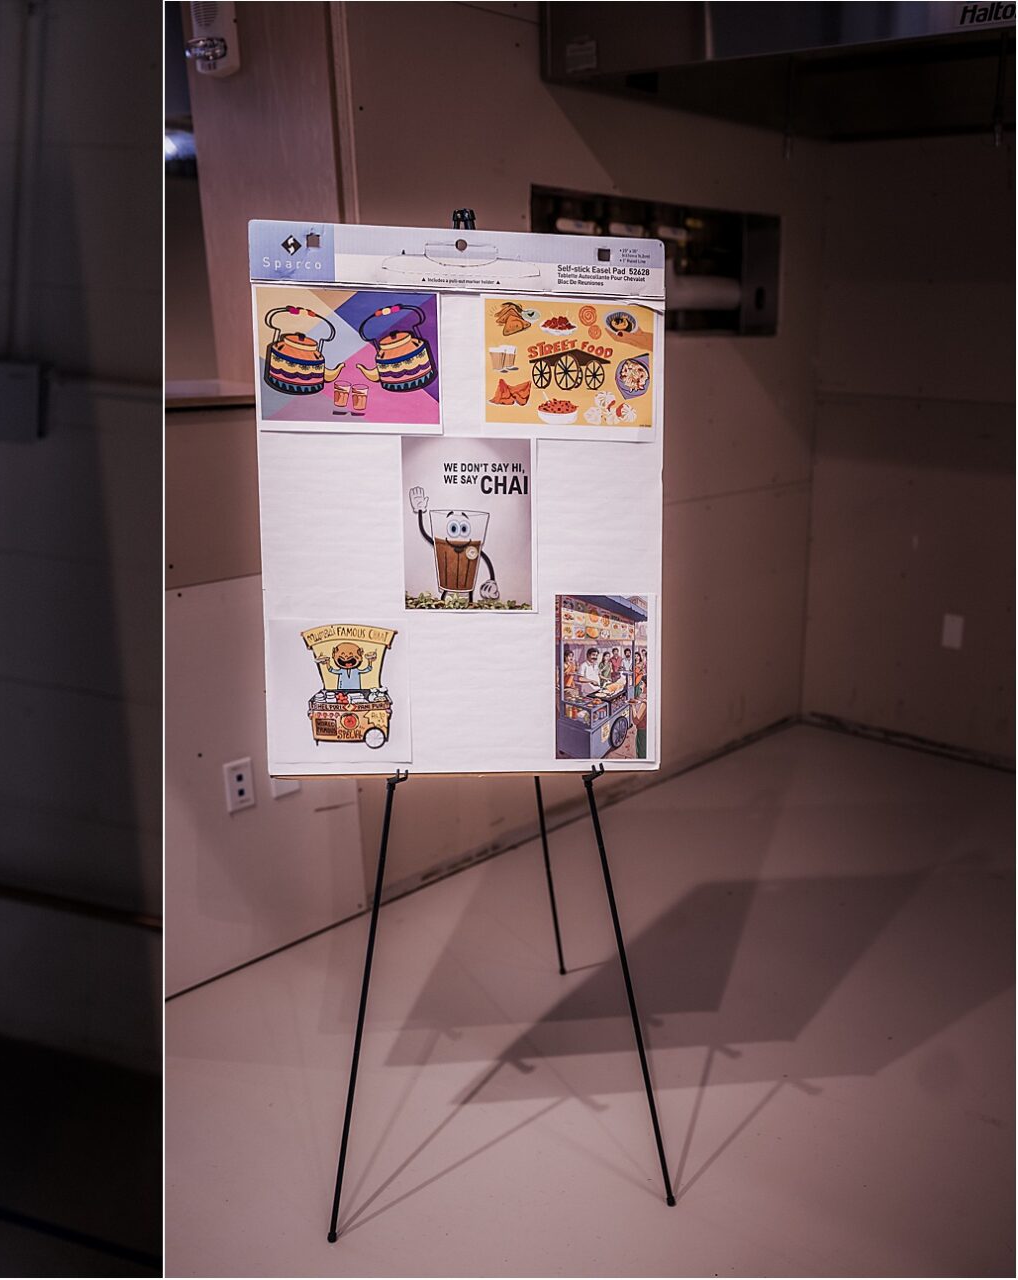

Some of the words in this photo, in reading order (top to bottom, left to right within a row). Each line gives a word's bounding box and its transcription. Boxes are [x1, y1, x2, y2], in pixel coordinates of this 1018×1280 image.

[960, 2, 1016, 25] Halto
[262, 256, 322, 270] Sparco
[557, 265, 590, 273] Self-stick
[591, 266, 611, 274] Easel
[612, 267, 626, 275] Pad
[628, 268, 650, 276] 52628
[527, 339, 578, 359] STREET
[581, 341, 614, 358] FOOD
[443, 463, 458, 472] WE
[460, 463, 489, 472] DON'T
[491, 463, 510, 473] SAY
[511, 463, 525, 474] HI,
[443, 475, 458, 484] WE
[460, 475, 478, 484] SAY
[480, 475, 529, 495] CHAI
[336, 626, 366, 639] FAMOUS
